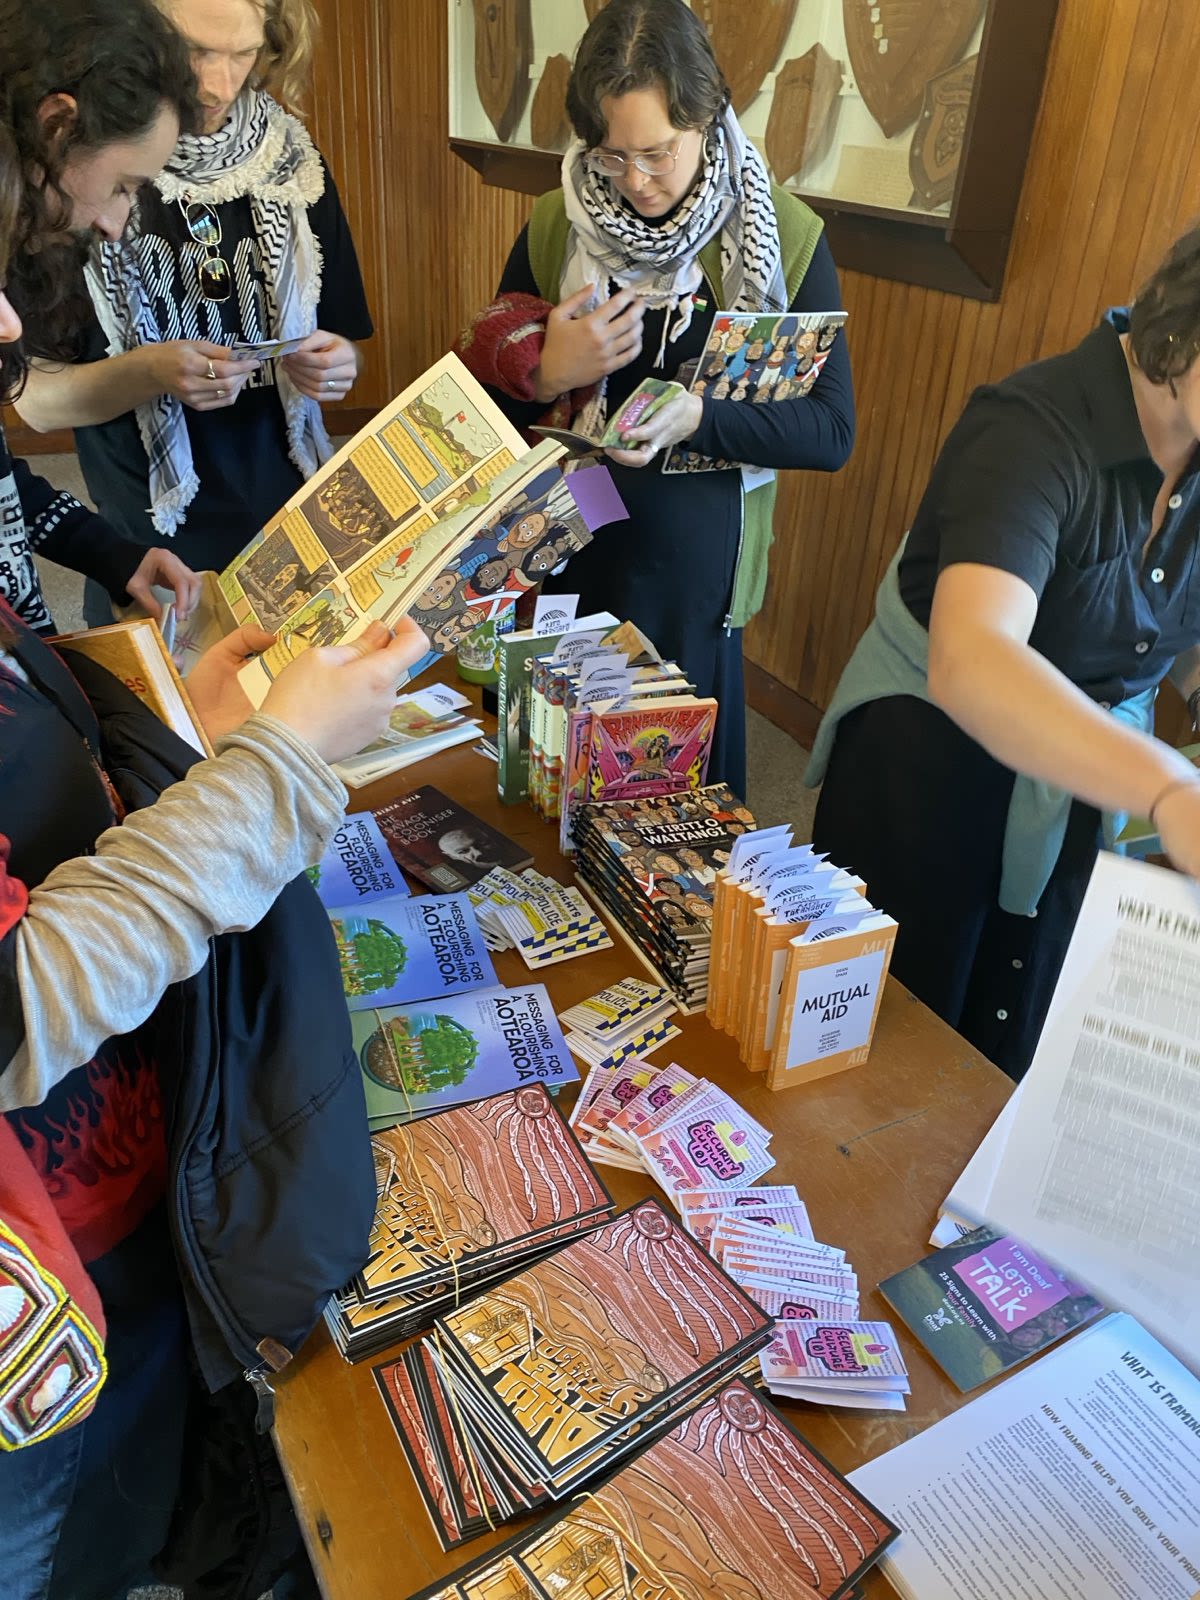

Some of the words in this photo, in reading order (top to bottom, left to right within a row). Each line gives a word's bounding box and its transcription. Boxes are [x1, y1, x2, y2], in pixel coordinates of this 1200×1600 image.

[500, 672, 506, 690] NO
[384, 812, 427, 835] SAVAGE
[392, 809, 454, 839] COLONISER
[400, 828, 436, 845] BOOK
[636, 825, 654, 836] TE
[660, 820, 705, 834] TIRITI
[708, 818, 718, 828] O
[644, 827, 727, 846] WAITANGI
[350, 838, 384, 892] FLOURISHING
[354, 820, 385, 869] MESSAGING
[379, 872, 395, 889] FOR
[534, 895, 562, 926] POLICE
[420, 905, 459, 986] AOTEAROA
[442, 920, 471, 982] FLOURISHING
[448, 901, 475, 956] MESSAGING
[468, 962, 484, 980] FOR
[596, 990, 632, 1008] POLICE
[802, 983, 870, 1014] MUTUAL
[820, 1004, 848, 1023] AID
[494, 999, 535, 1081] AOTEAROA
[517, 1013, 548, 1077] FLOURISHING
[524, 993, 554, 1050] MESSAGING
[546, 1055, 563, 1075] FOR
[692, 1145, 708, 1164] 101
[693, 1129, 728, 1175] CULTURE
[702, 1125, 740, 1171] SECURITY
[969, 1257, 1026, 1321] TALK
[1014, 1251, 1029, 1266] am
[1027, 1266, 1052, 1289] Deaf
[925, 1314, 941, 1331] Deaf
[939, 1272, 949, 1280] 25
[946, 1280, 962, 1297] Signs
[960, 1297, 968, 1305] to
[967, 1305, 983, 1324] Learn
[982, 1324, 996, 1340] with
[946, 1290, 959, 1305] Your
[958, 1306, 976, 1328] Family
[812, 1341, 826, 1355] 101
[823, 1330, 844, 1368] CULTURE
[835, 1330, 859, 1369] SECURITY
[1120, 1352, 1154, 1379] WHAT
[1148, 1381, 1165, 1393] IS
[1041, 1404, 1061, 1423] HOW
[1059, 1425, 1093, 1460] FRAMING
[1091, 1460, 1116, 1486] HELPS
[1116, 1486, 1134, 1505] YOU
[1157, 1532, 1180, 1557] YOUR
